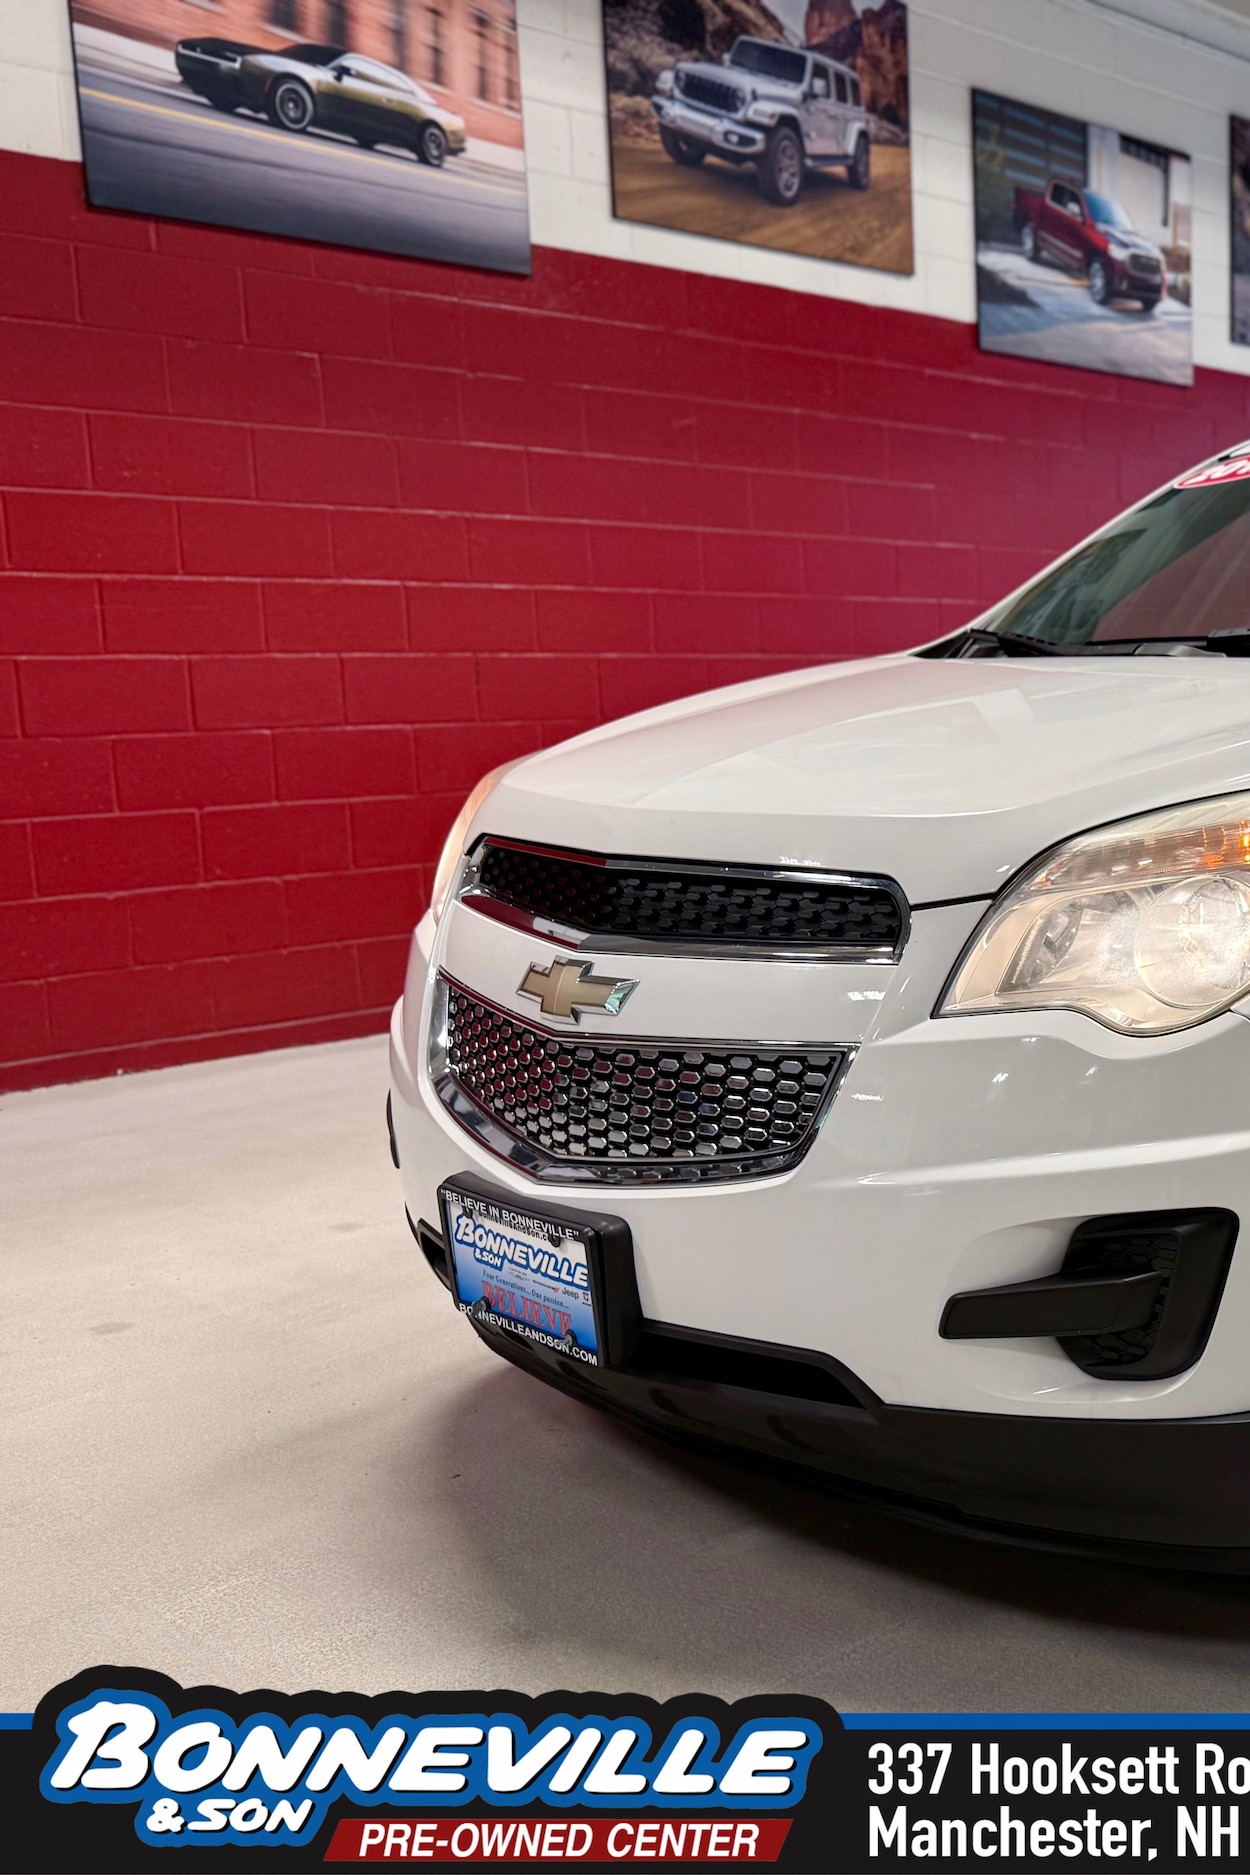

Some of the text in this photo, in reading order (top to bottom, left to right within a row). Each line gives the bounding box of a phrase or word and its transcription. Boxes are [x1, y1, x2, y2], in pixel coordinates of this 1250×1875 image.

[489, 1205, 499, 1217] IN
[456, 1216, 588, 1287] BONNEVILLE
[482, 1280, 572, 1336] BELIEVE
[561, 1286, 580, 1300] Jeep
